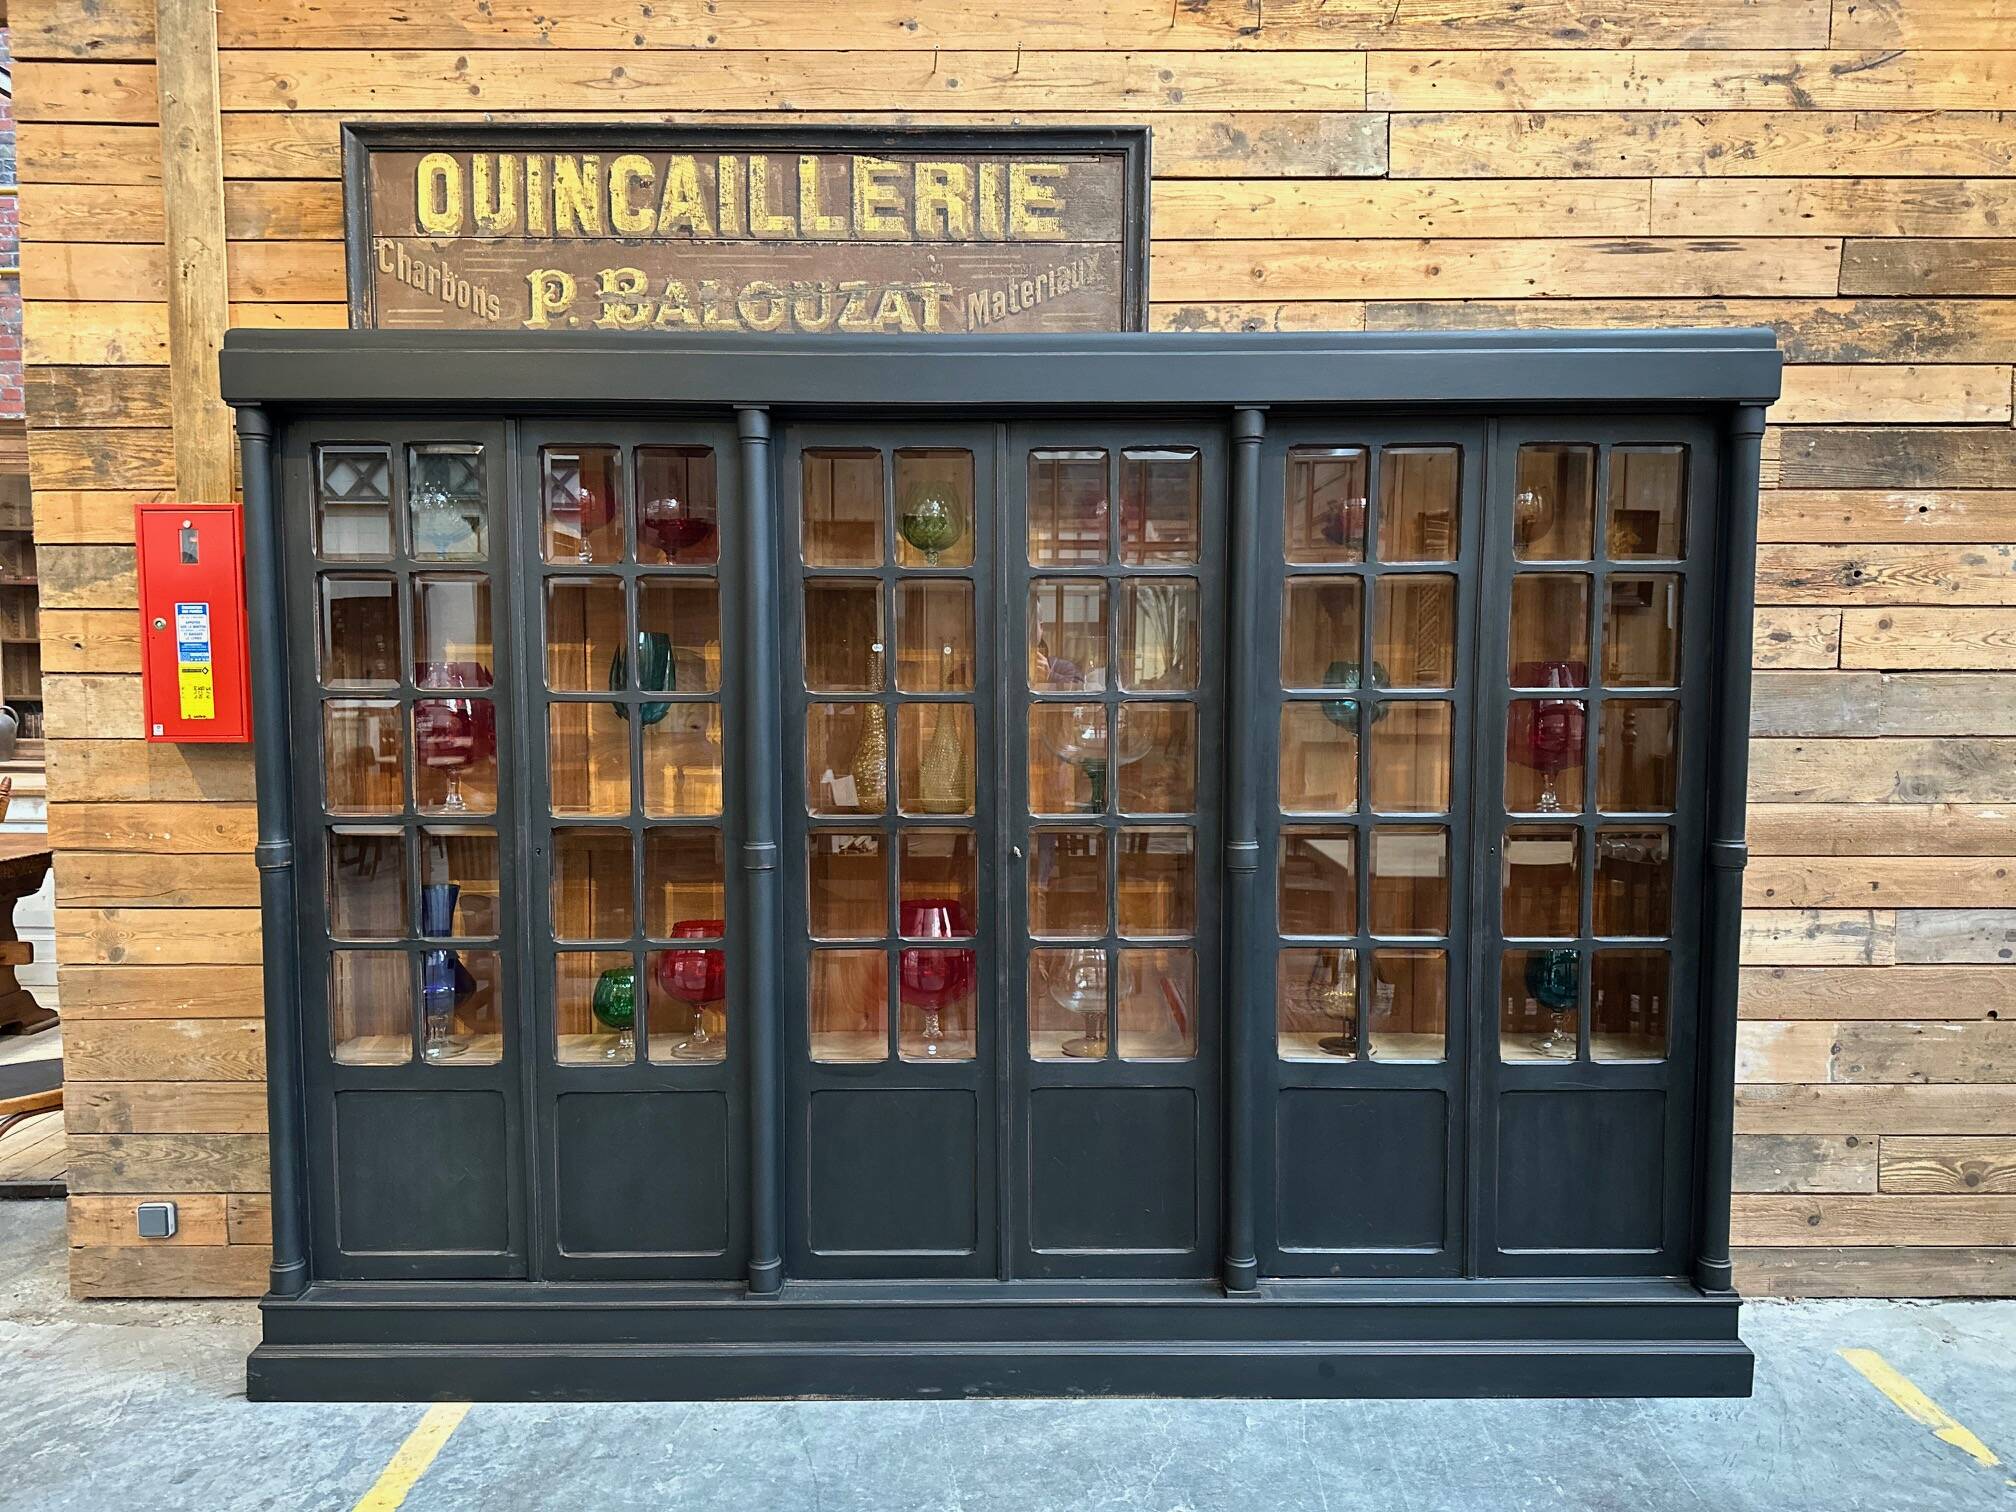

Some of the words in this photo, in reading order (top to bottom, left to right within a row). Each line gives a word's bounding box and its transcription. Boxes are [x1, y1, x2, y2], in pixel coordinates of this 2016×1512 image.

[416, 152, 1070, 239] QUINCAILLERIE
[378, 237, 500, 321] Charbons
[522, 267, 580, 330] P.
[593, 266, 952, 334] BALOUZAT
